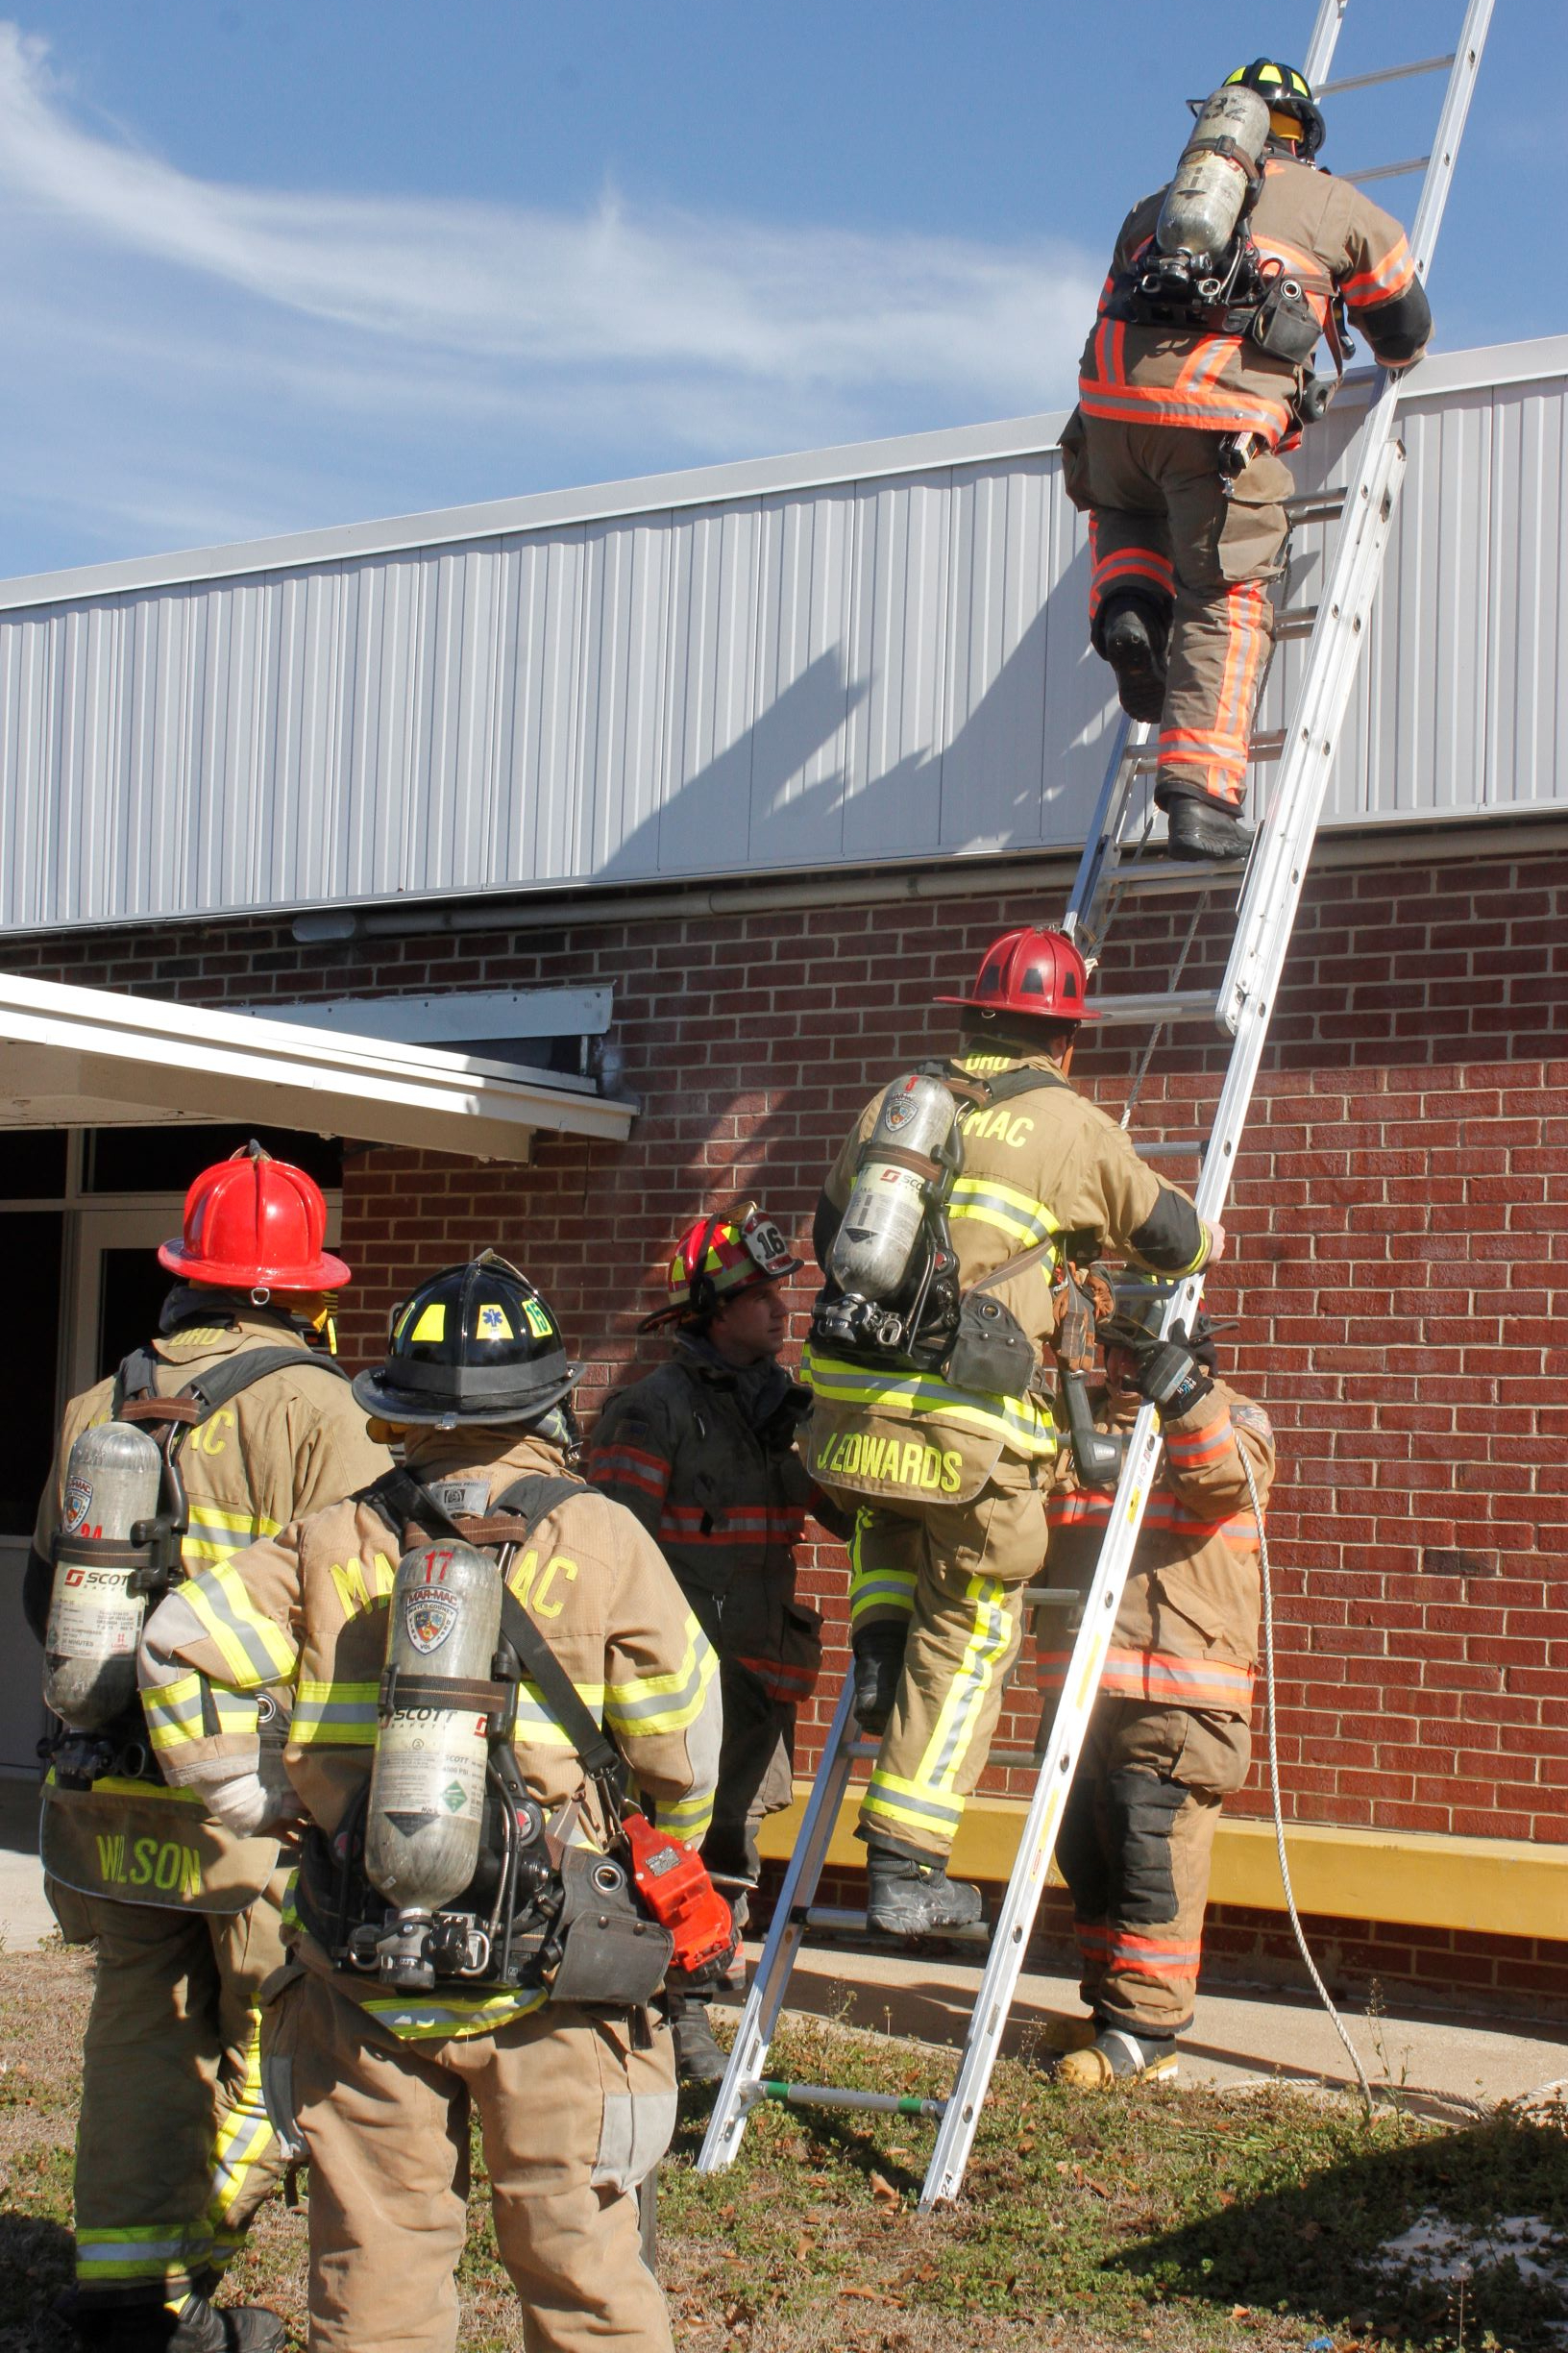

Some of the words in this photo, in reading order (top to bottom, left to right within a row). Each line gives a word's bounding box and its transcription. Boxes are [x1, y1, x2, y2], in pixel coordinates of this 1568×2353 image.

[757, 1227, 786, 1260] 16
[526, 1303, 549, 1334] 15
[86, 1572, 128, 1586] SCOT
[424, 1550, 454, 1584] 17
[407, 1589, 458, 1606] MAR-MAC
[394, 1707, 457, 1723] SCOTT
